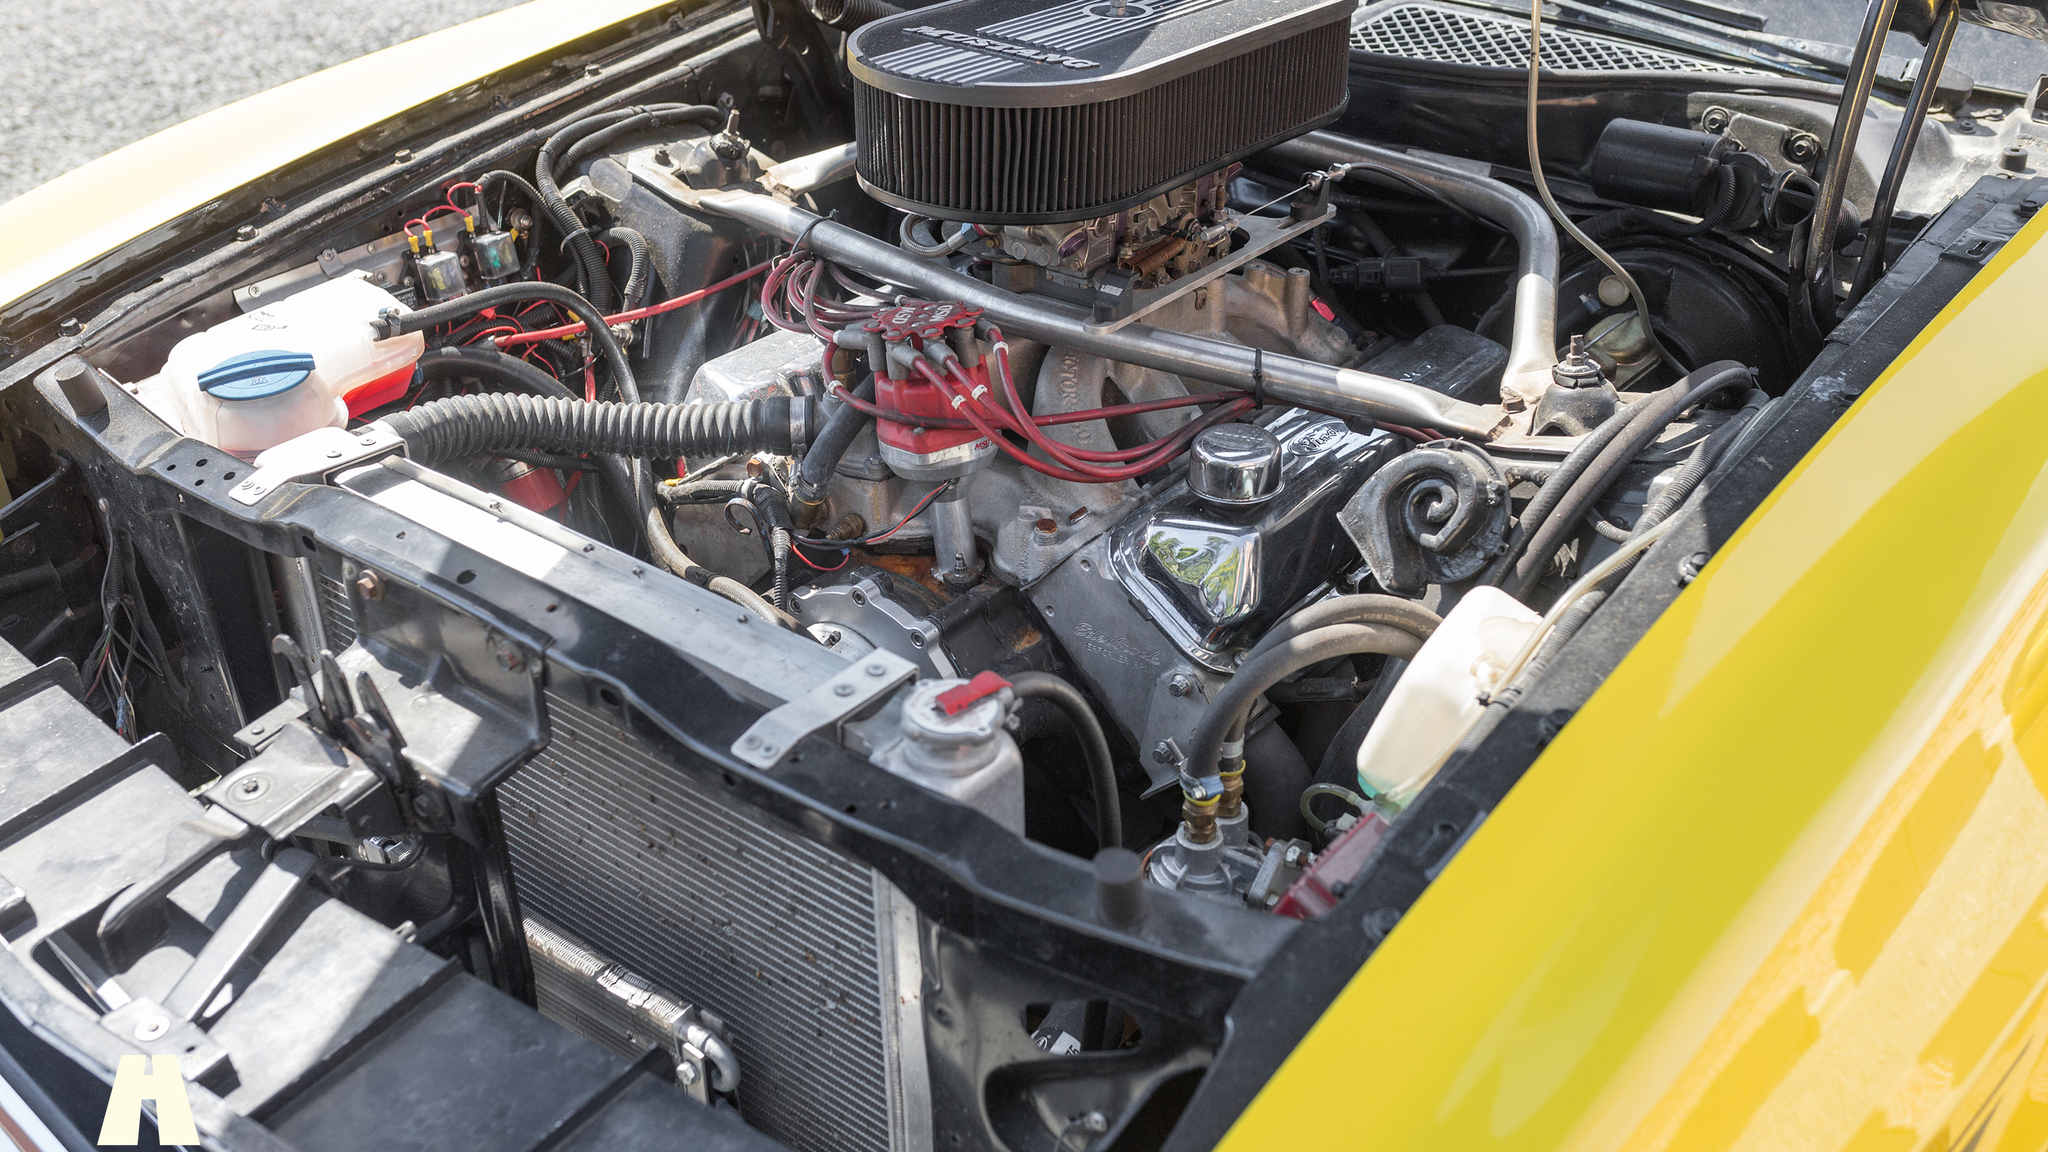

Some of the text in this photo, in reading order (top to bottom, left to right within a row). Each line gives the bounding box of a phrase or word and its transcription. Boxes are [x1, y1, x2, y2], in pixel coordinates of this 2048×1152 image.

[901, 25, 1101, 71] MUSTANG
[892, 306, 917, 325] MSD
[929, 304, 954, 322] MSD
[1298, 425, 1341, 448] Ford
[1073, 622, 1160, 666] Edelbrock
